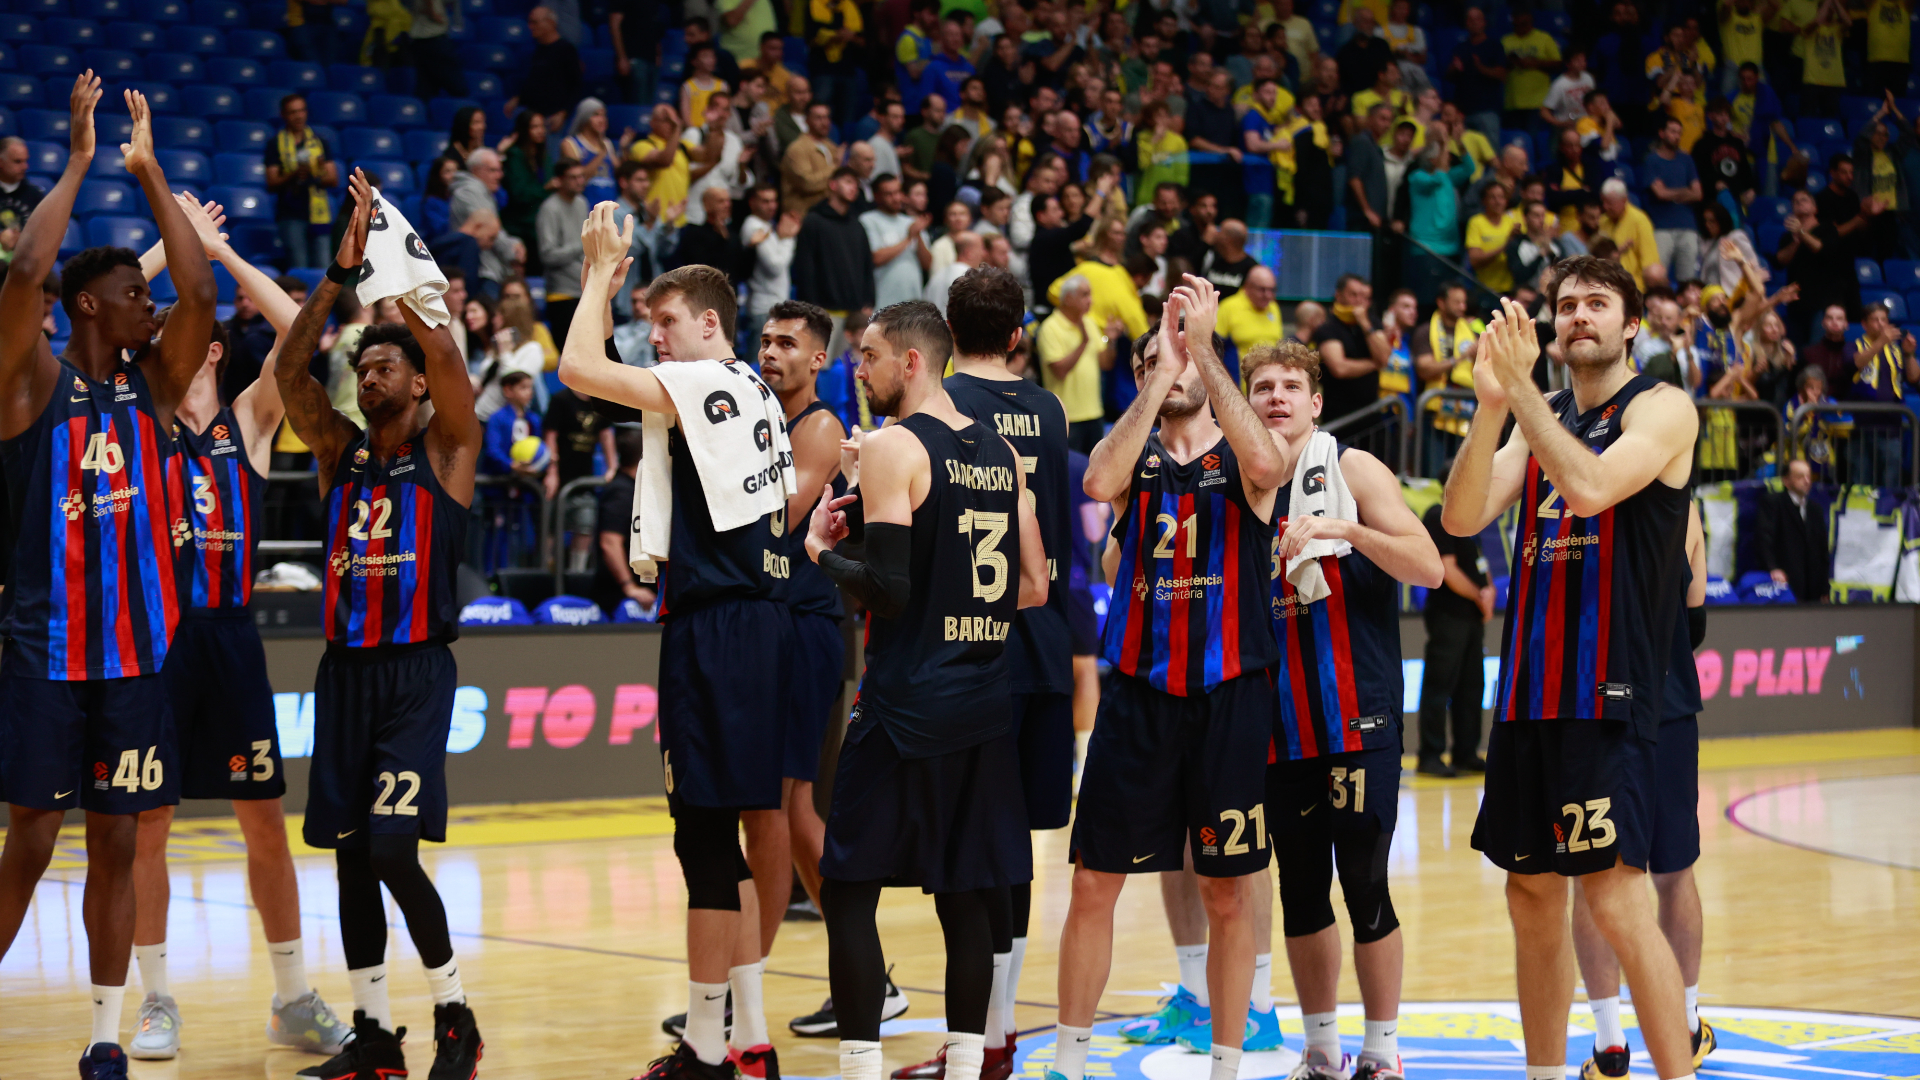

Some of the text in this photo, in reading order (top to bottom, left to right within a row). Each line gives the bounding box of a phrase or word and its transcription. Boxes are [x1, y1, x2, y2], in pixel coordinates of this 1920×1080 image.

[994, 413, 1040, 436] SANLI
[80, 432, 125, 476] 46
[193, 474, 216, 514] 3
[1537, 474, 1574, 519] 2
[348, 498, 392, 540] 22
[1153, 513, 1198, 559] 21
[352, 550, 416, 565] Assistència
[352, 564, 397, 577] Sanitària
[958, 508, 1009, 603] 13
[1540, 548, 1582, 563] Sanitària
[1155, 586, 1203, 601] Sanitària
[1156, 573, 1223, 588] Assistència
[1729, 646, 1832, 698] PLAY
[504, 684, 597, 749] TO
[112, 745, 164, 793] 46
[251, 739, 275, 782] 3
[373, 770, 421, 816] 22
[1331, 766, 1365, 813] 31
[1220, 803, 1266, 856] 21
[1561, 797, 1617, 853] 23
